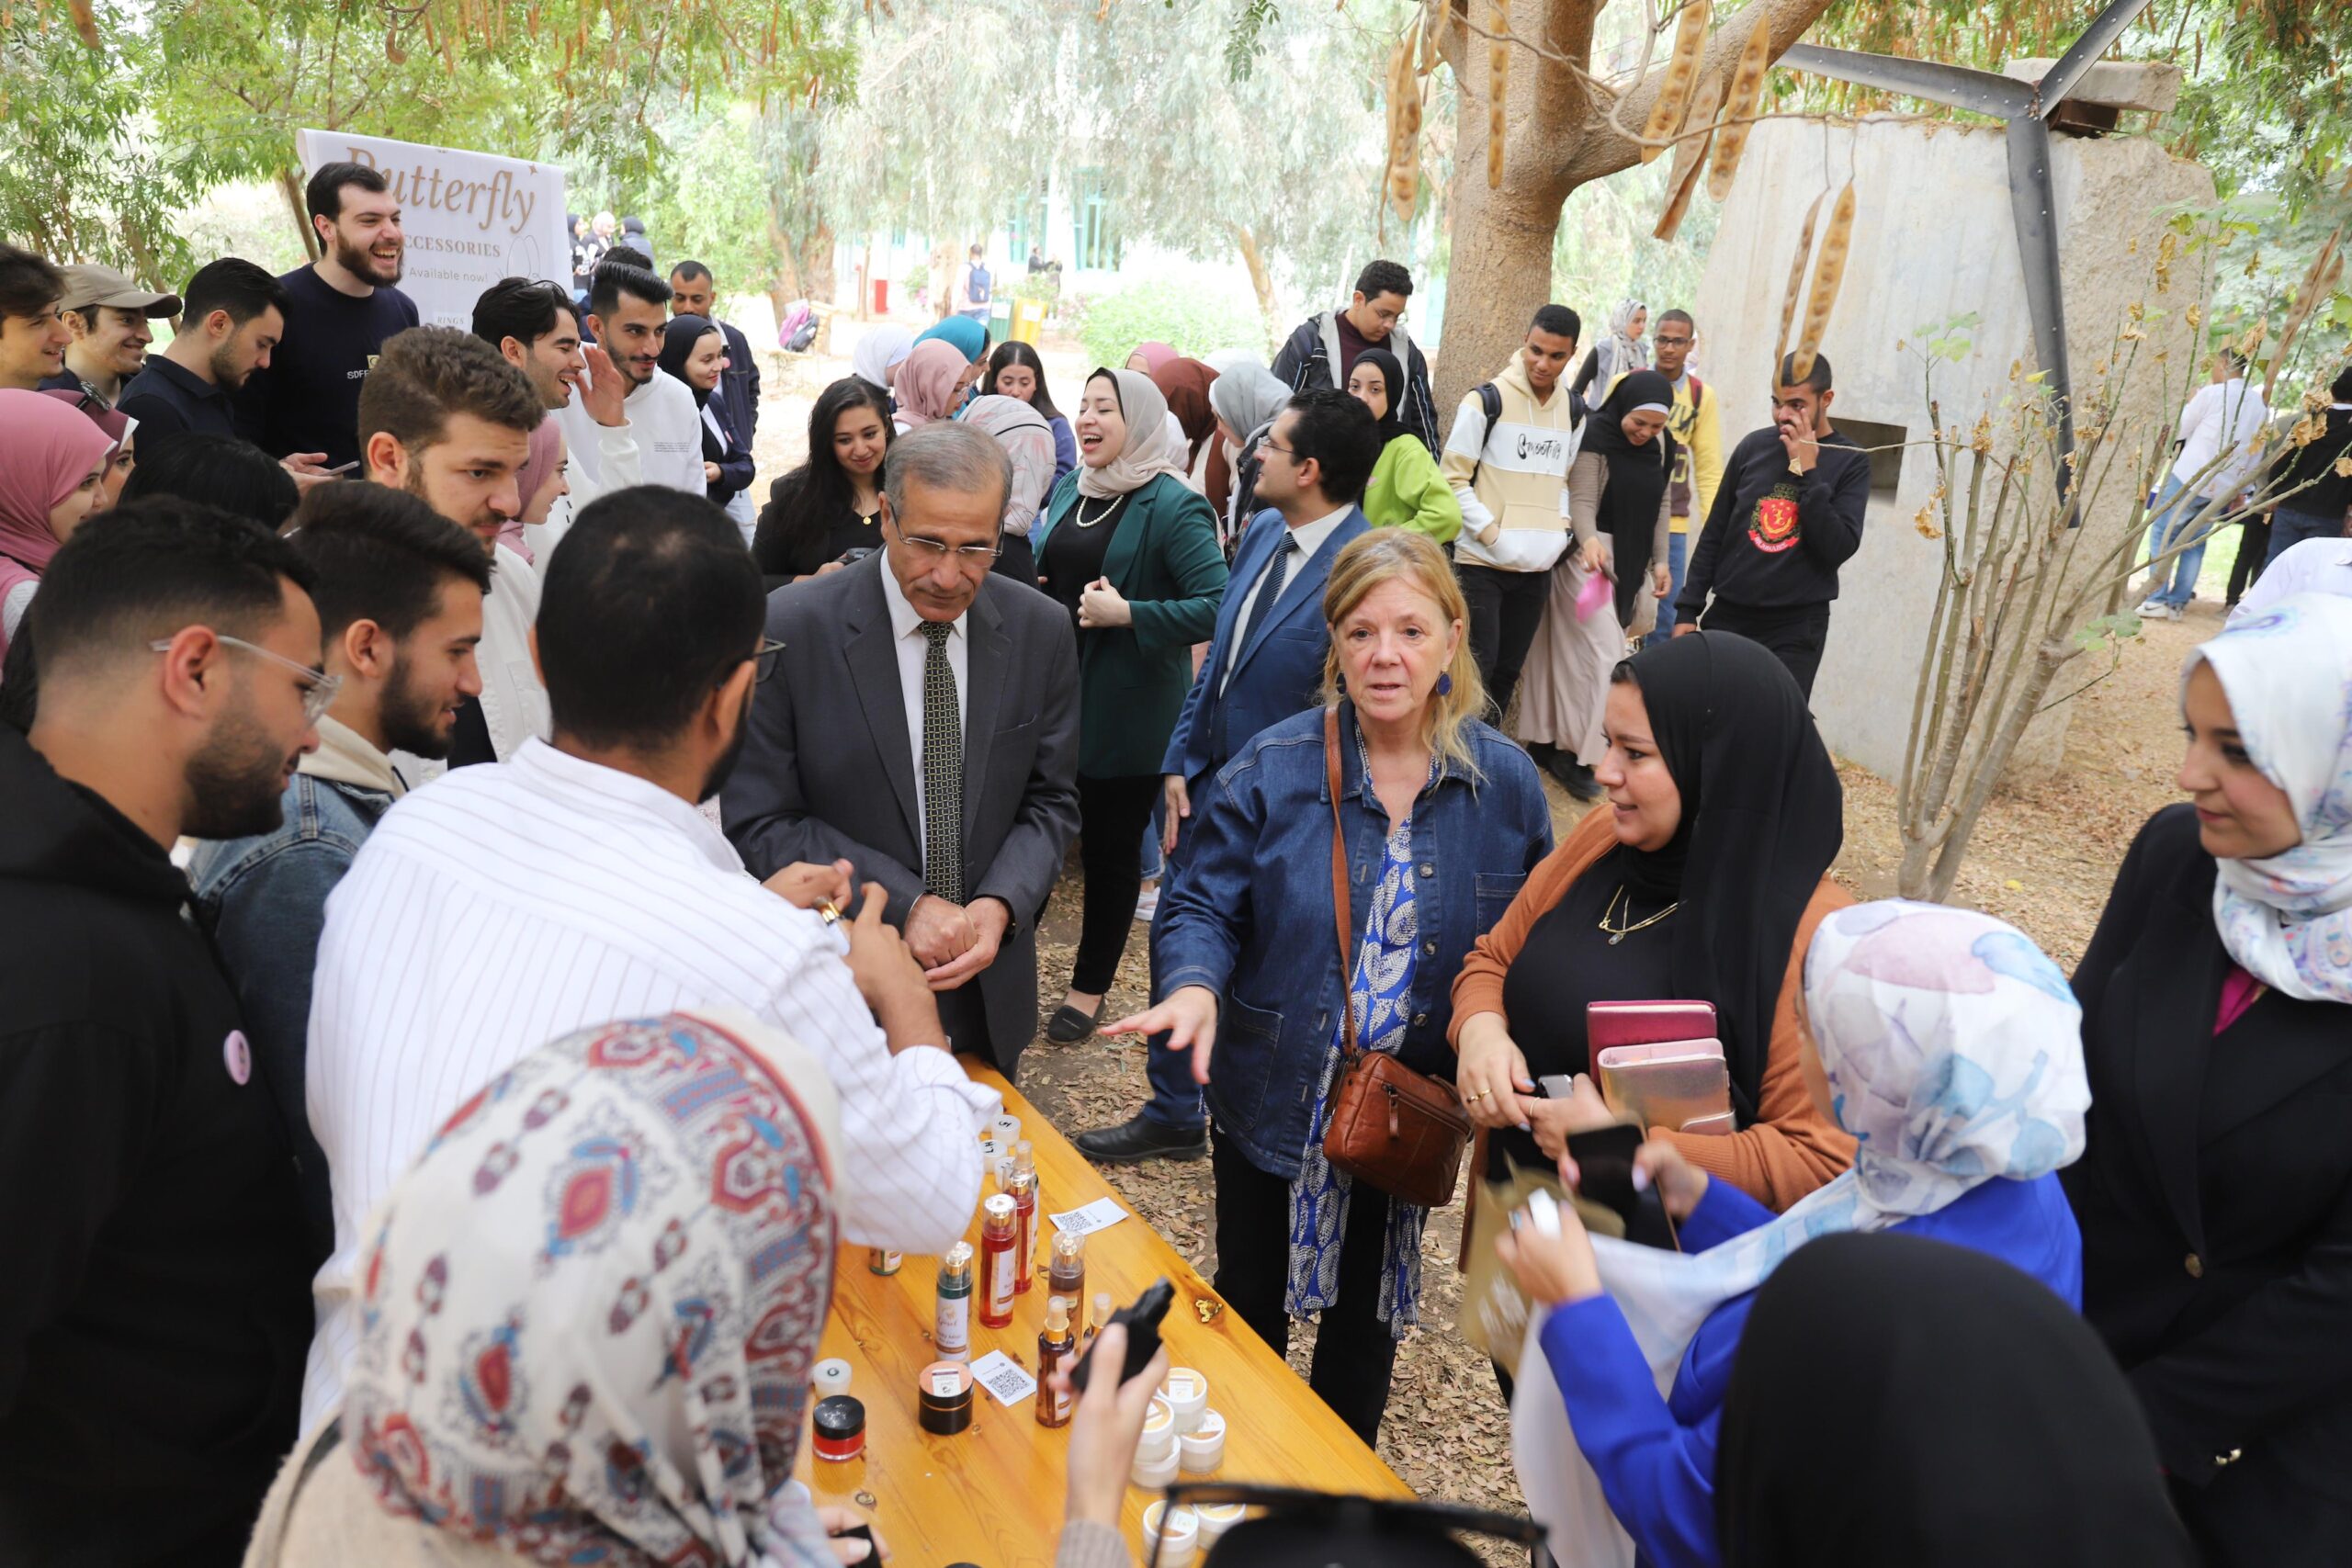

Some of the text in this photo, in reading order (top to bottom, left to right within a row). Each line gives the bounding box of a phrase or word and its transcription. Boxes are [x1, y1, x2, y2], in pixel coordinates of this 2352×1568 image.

[404, 234, 501, 258] CCESSORIES
[410, 267, 489, 283] Available now!
[437, 316, 465, 325] RINGS
